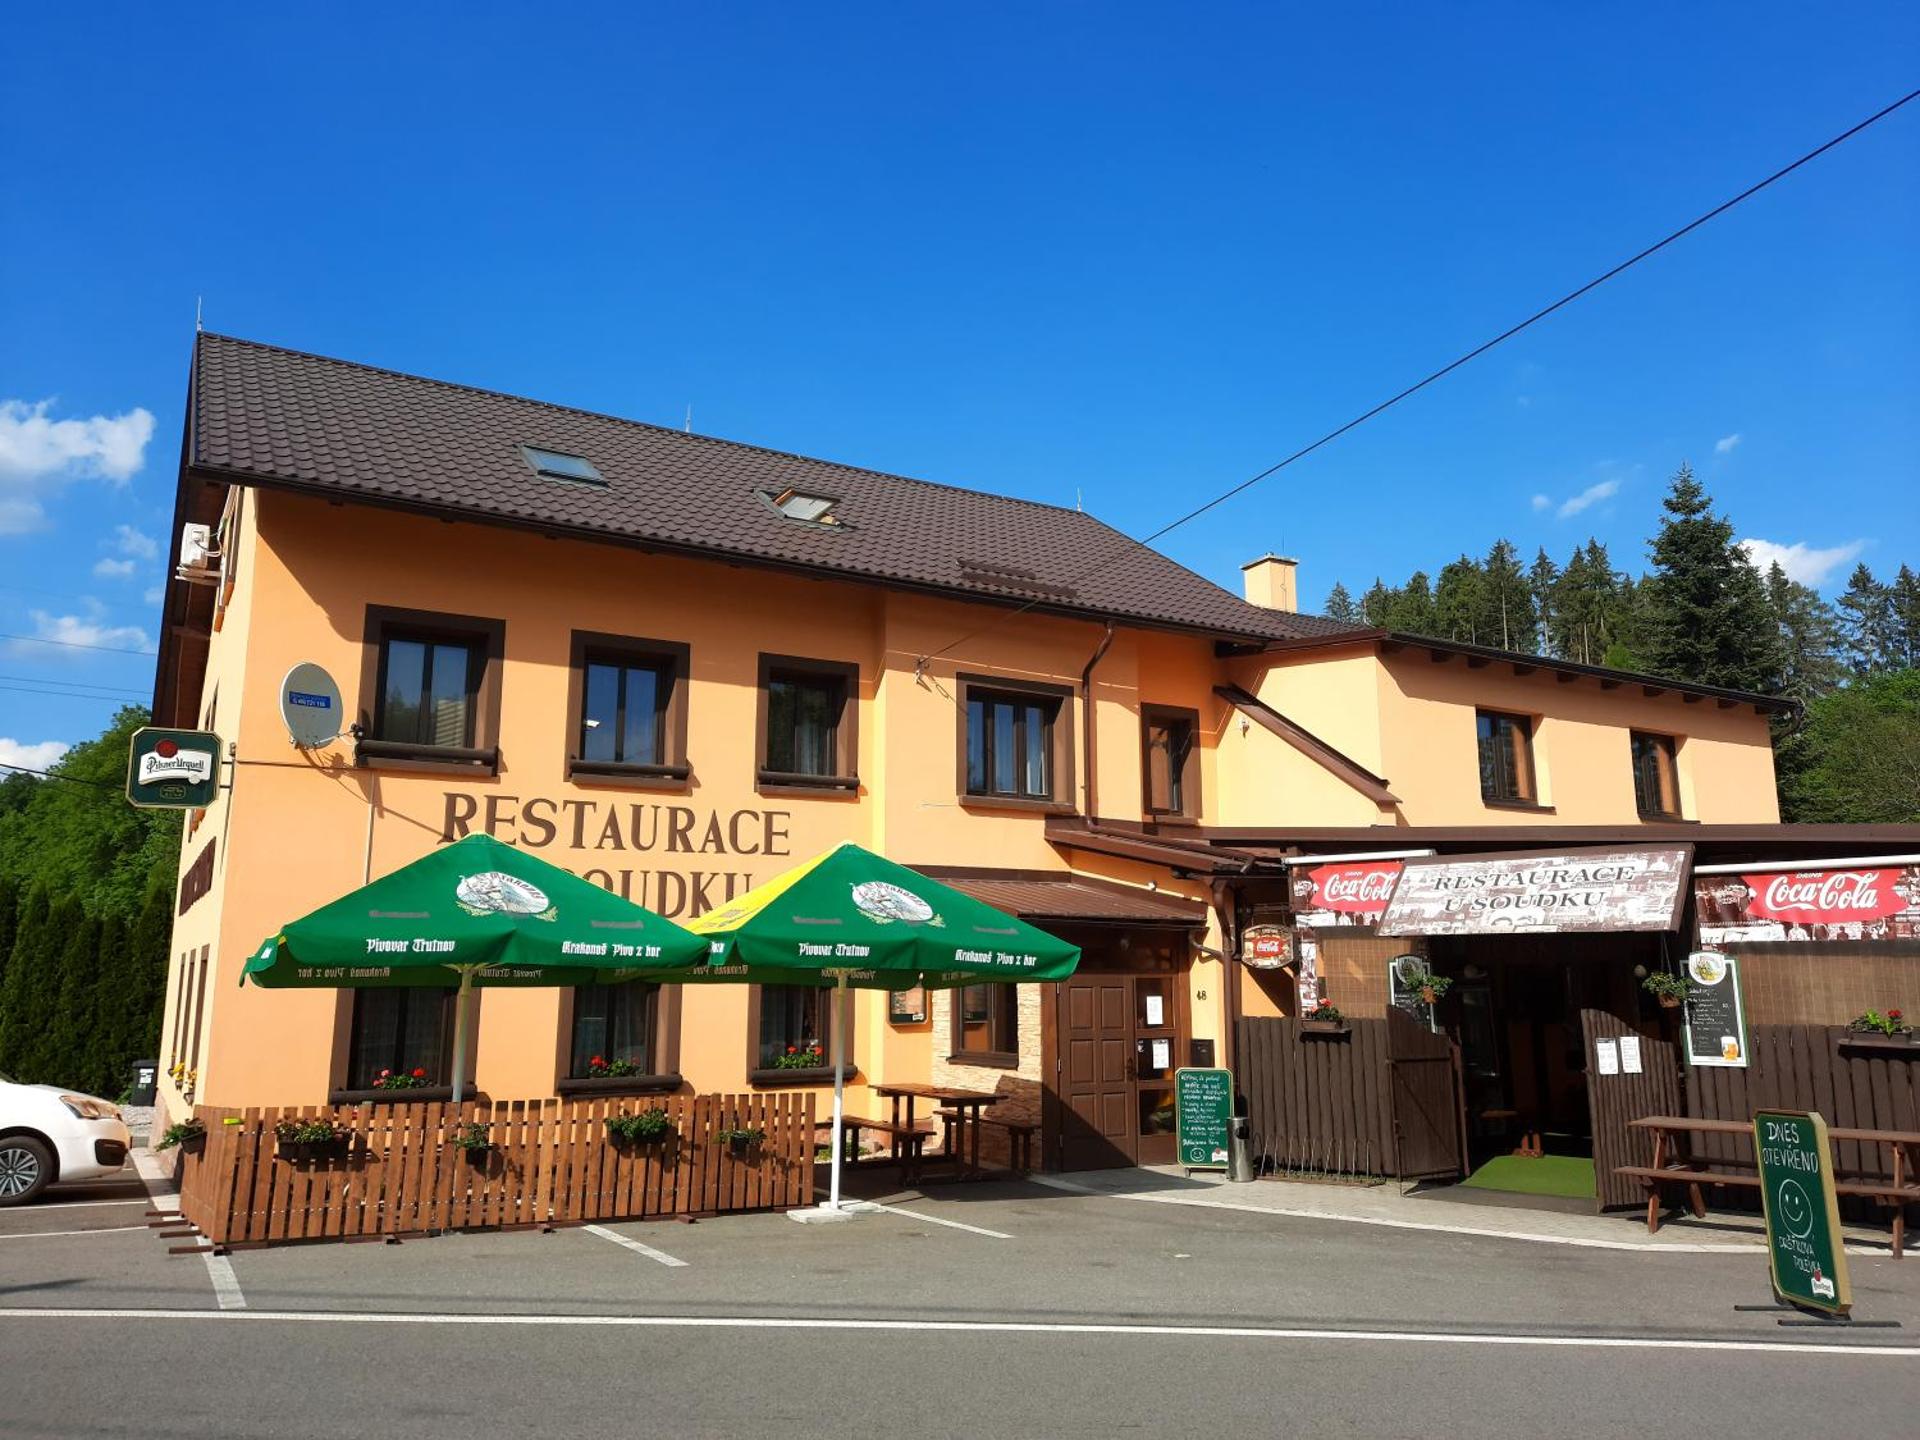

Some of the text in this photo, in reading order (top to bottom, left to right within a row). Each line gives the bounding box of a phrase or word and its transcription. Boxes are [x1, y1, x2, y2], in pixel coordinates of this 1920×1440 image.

[436, 791, 791, 856] RESTAURACE
[1434, 864, 1636, 891] RESTAURACE
[560, 867, 753, 919] UDK
[1445, 891, 1607, 912] U SOUDKU
[1765, 871, 1880, 911] Coca-Cola
[366, 938, 456, 954] Pivovar Trutnov
[612, 943, 634, 957] Pivo
[636, 946, 642, 956] z
[799, 942, 870, 957] Pivovar Trutnov
[996, 952, 1014, 965] Pivo
[1015, 955, 1021, 965] z
[1766, 1122, 1800, 1144] DNES
